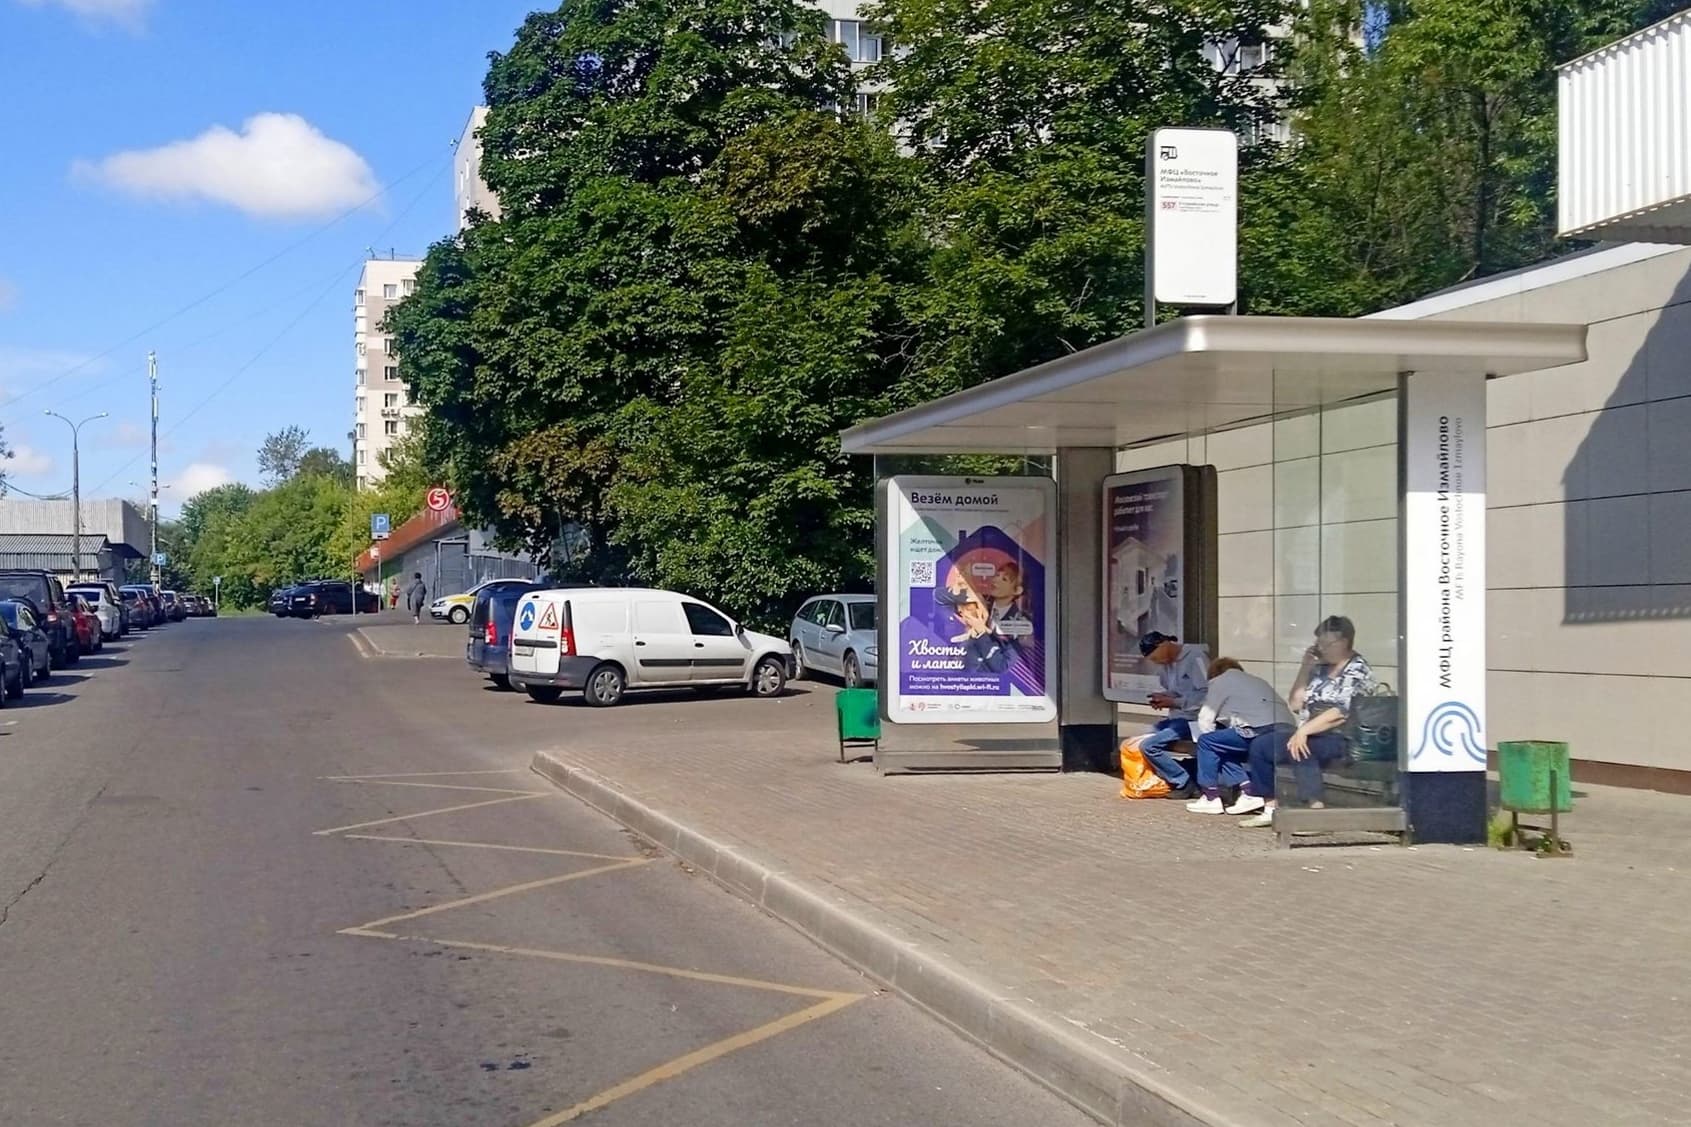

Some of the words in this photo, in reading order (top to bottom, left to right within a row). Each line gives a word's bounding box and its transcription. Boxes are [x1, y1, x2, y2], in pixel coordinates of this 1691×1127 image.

[1437, 415, 1449, 501] Измайлово
[911, 492, 952, 505] Везём
[955, 494, 998, 506] домой
[377, 516, 386, 529] P
[1438, 506, 1450, 584] Восточное
[1438, 590, 1453, 643] района
[909, 639, 967, 657] Хвосты
[911, 660, 922, 670] и
[923, 660, 965, 670] лапки
[1438, 647, 1453, 688] МФЦ
[909, 675, 946, 683] Посмотреть
